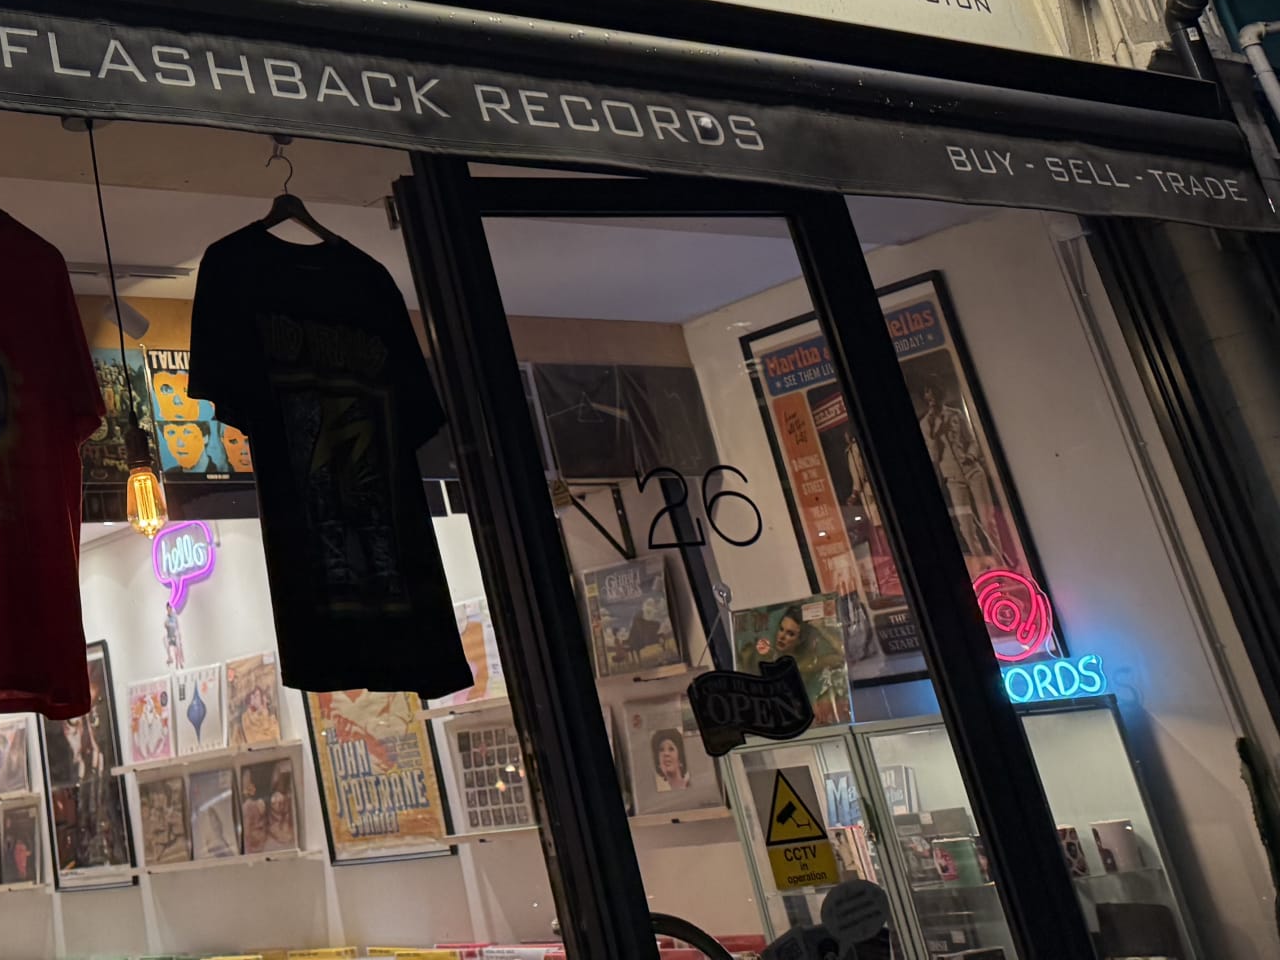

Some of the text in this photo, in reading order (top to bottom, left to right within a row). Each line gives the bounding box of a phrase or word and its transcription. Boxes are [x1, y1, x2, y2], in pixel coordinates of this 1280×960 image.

[475, 82, 765, 151] RECORDS
[946, 146, 1015, 176] BUY
[1044, 155, 1130, 189] SELL
[1148, 168, 1248, 203] TRADE
[765, 308, 936, 377] Martha ellas
[822, 362, 836, 377] LIV
[894, 334, 925, 354] RIDAY!
[634, 464, 763, 550] 26
[161, 534, 208, 574] hello
[1005, 654, 1102, 703] ORDS
[706, 690, 805, 728] OPEN
[783, 845, 817, 862] CCTV
[800, 862, 809, 871] in
[787, 872, 827, 885] operation
